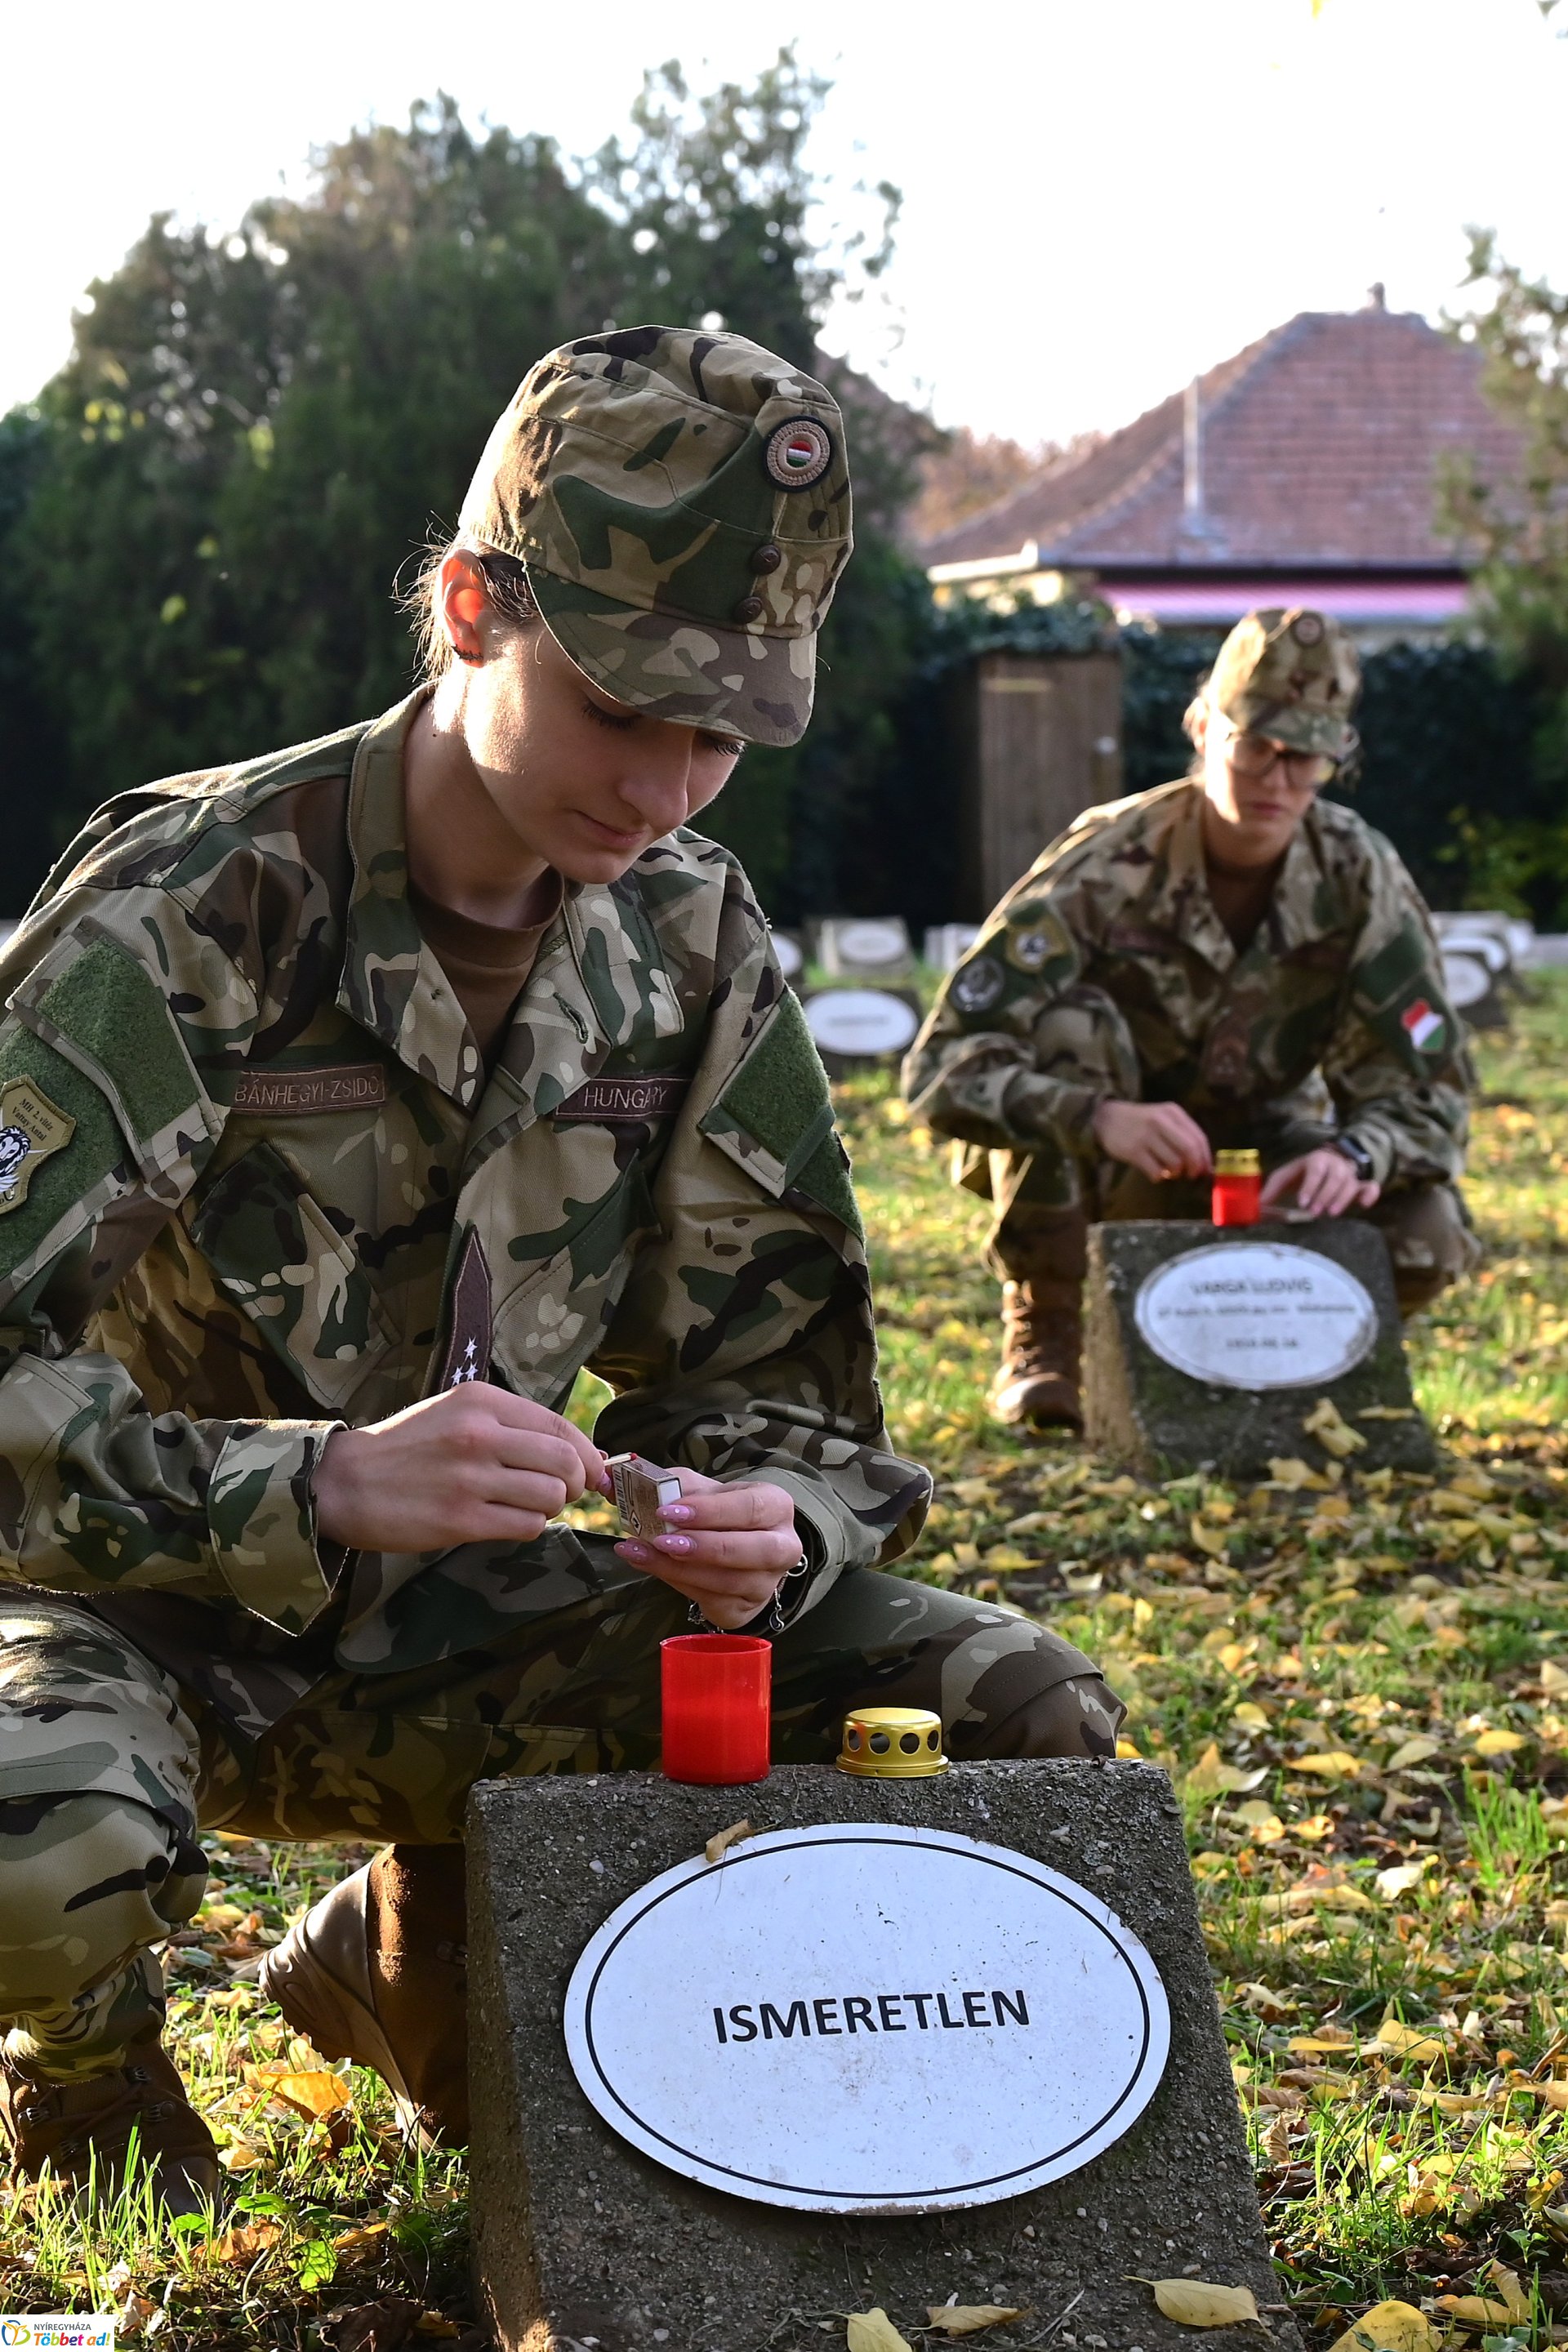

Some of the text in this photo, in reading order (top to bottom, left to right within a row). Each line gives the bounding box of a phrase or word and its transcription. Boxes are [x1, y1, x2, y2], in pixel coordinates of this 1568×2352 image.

[585, 1086, 667, 1109] HUNGARY
[12, 1107, 47, 1141] Vattay Antal
[20, 1098, 34, 1112] MH
[39, 1116, 53, 1131] vitéz
[713, 1989, 1030, 2044] ISMERETLEN
